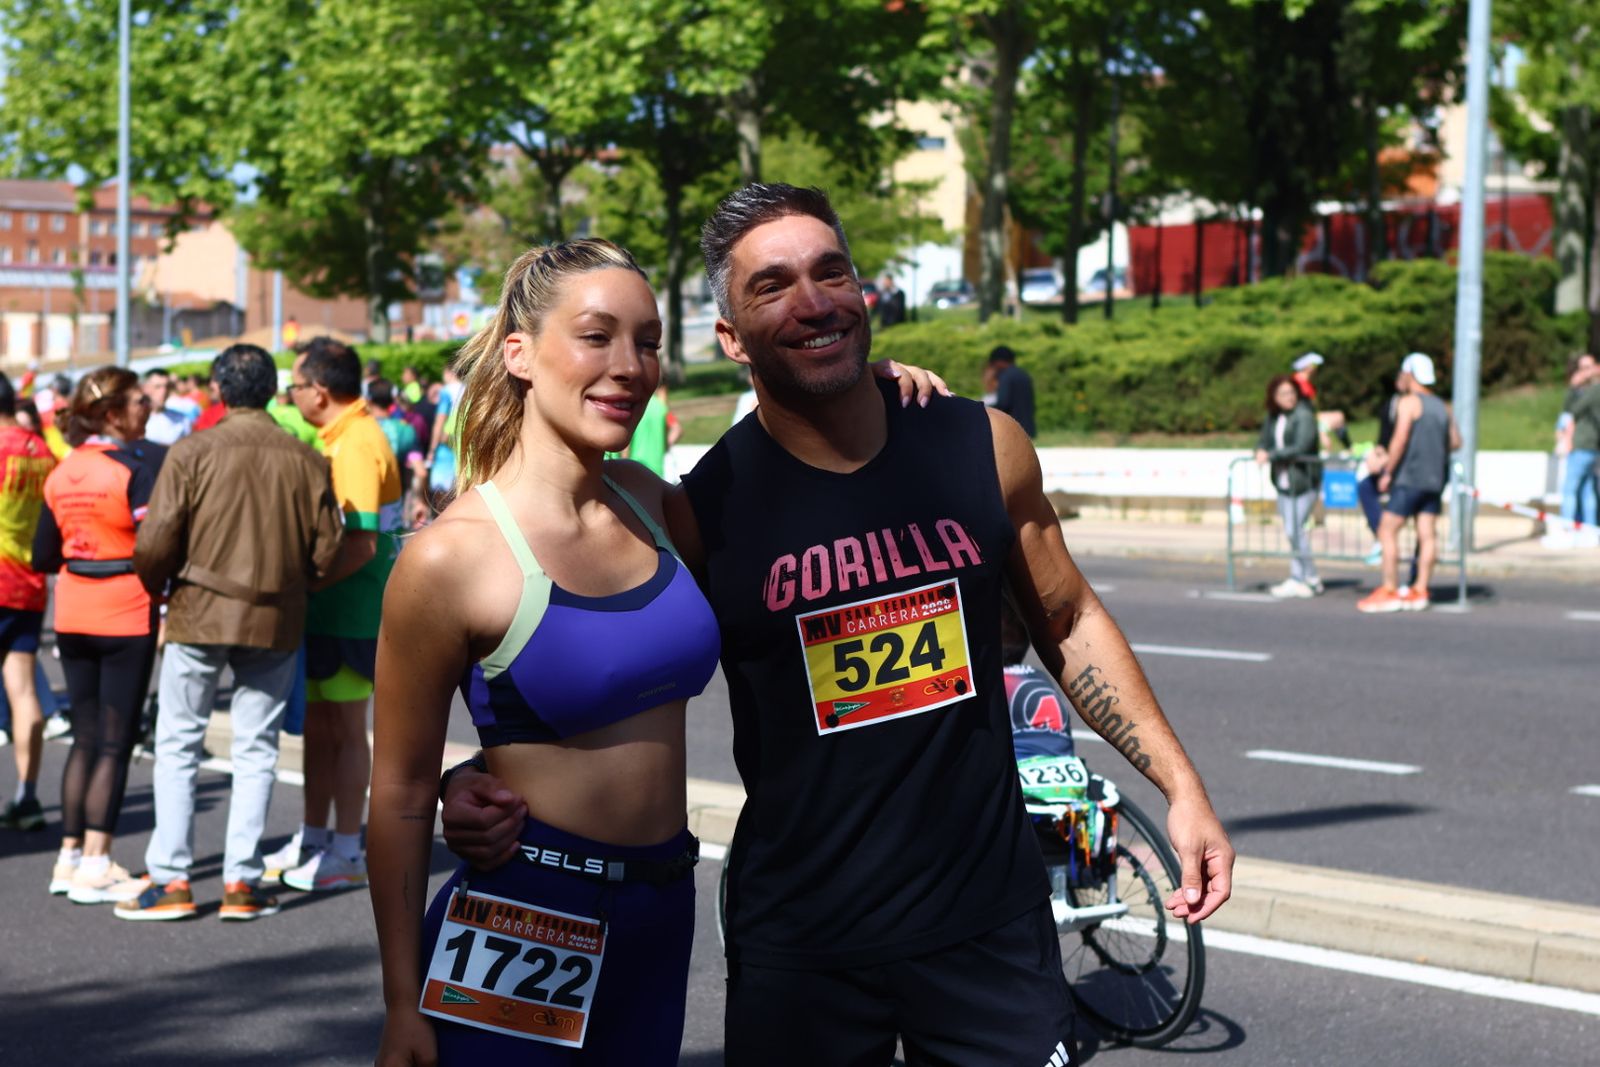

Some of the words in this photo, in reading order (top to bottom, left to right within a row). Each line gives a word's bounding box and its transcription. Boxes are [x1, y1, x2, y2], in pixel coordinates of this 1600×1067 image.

[763, 519, 982, 612] GORILLA
[847, 608, 918, 632] CARRERA
[833, 621, 945, 692] 524
[452, 898, 492, 924] XIV
[491, 915, 565, 944] CARRERA
[445, 928, 593, 1009] 1722
